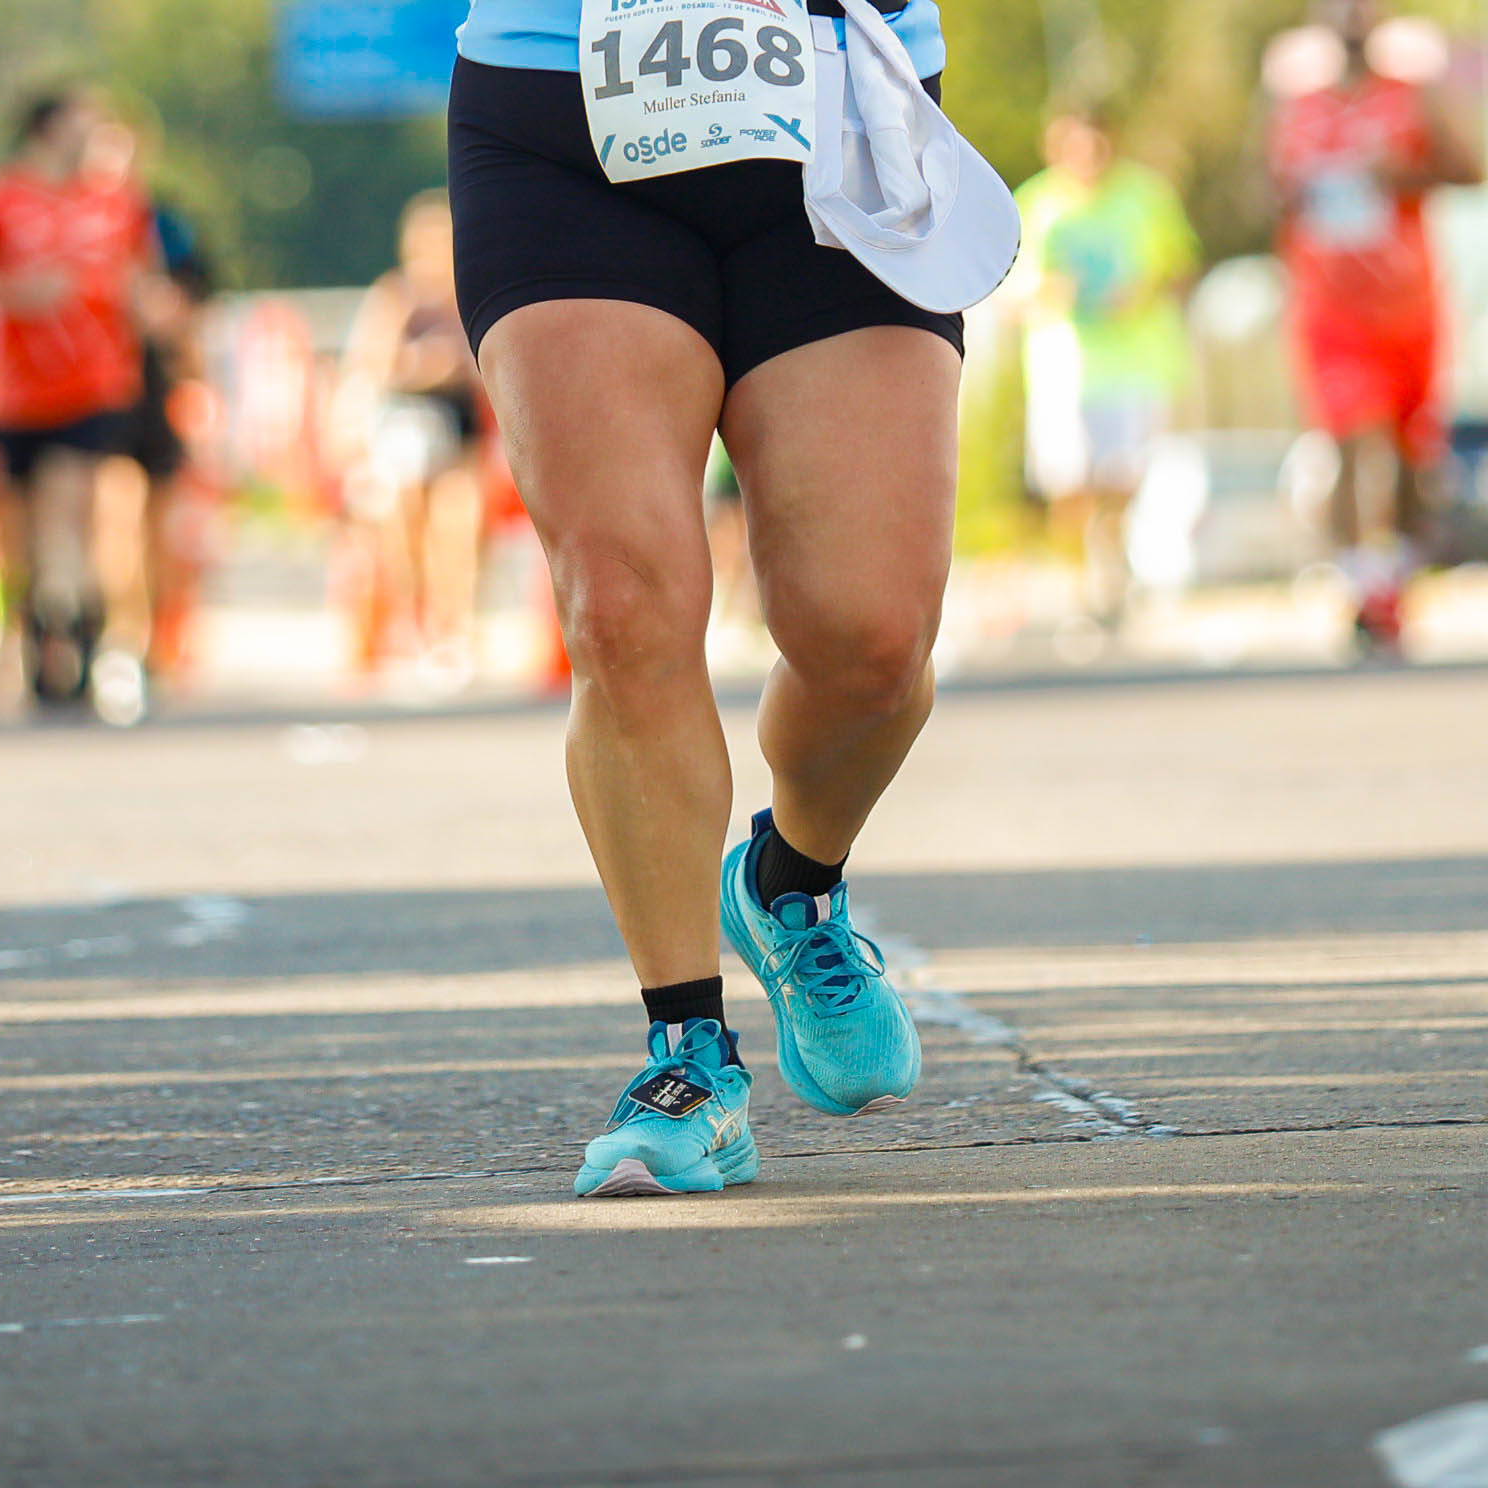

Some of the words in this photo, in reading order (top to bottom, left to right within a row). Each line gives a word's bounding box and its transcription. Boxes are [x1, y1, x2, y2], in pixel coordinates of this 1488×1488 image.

[591, 16, 805, 101] 1468
[642, 95, 686, 115] Muller
[690, 88, 746, 108] Stefania
[623, 127, 688, 164] osde
[739, 128, 777, 137] POWER
